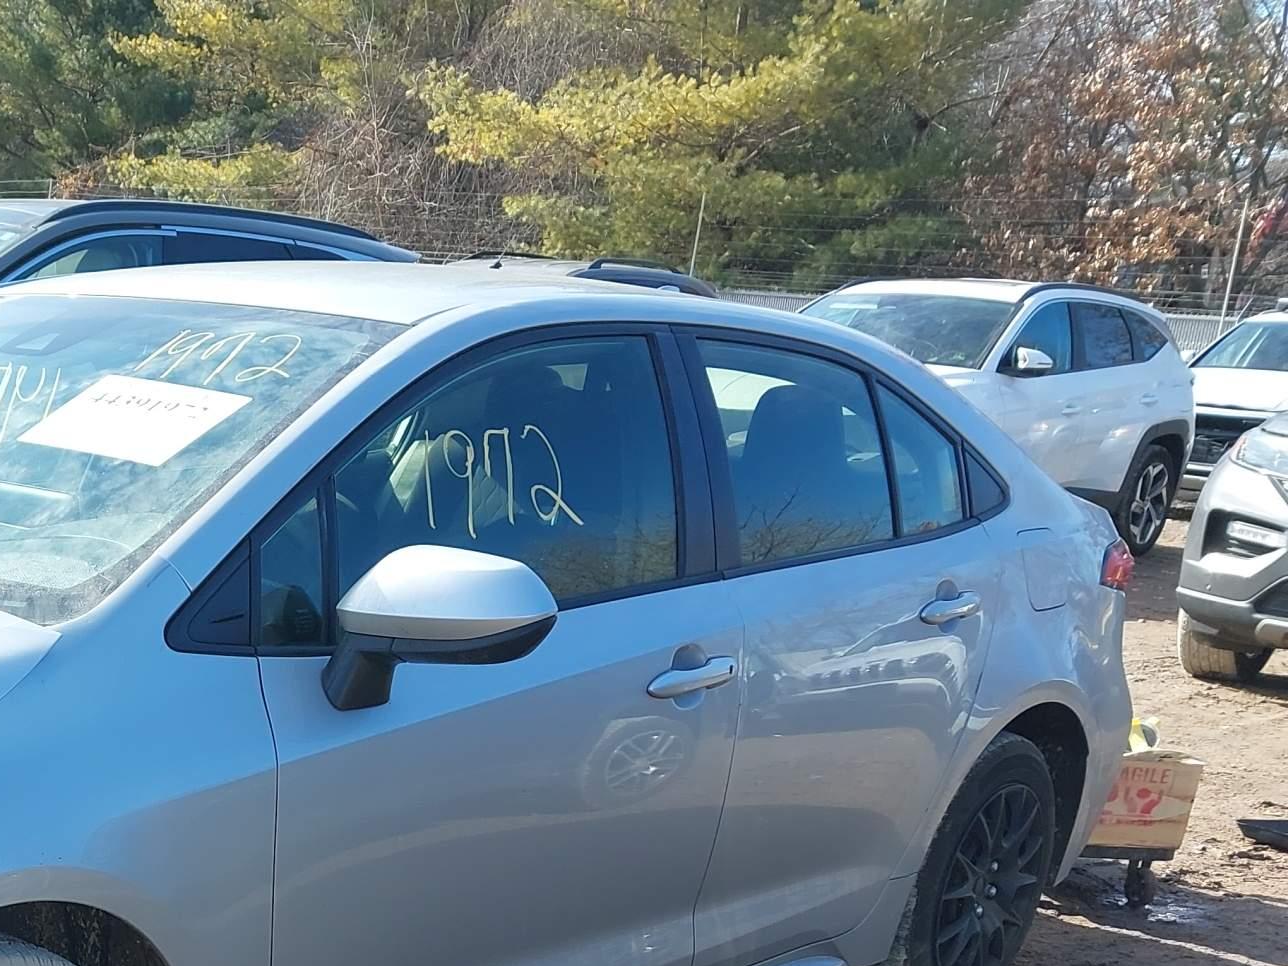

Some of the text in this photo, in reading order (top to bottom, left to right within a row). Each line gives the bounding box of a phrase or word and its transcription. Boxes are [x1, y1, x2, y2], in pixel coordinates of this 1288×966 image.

[134, 329, 291, 386] 1972
[424, 424, 585, 540] 1972
[1119, 766, 1173, 784] AGILE
